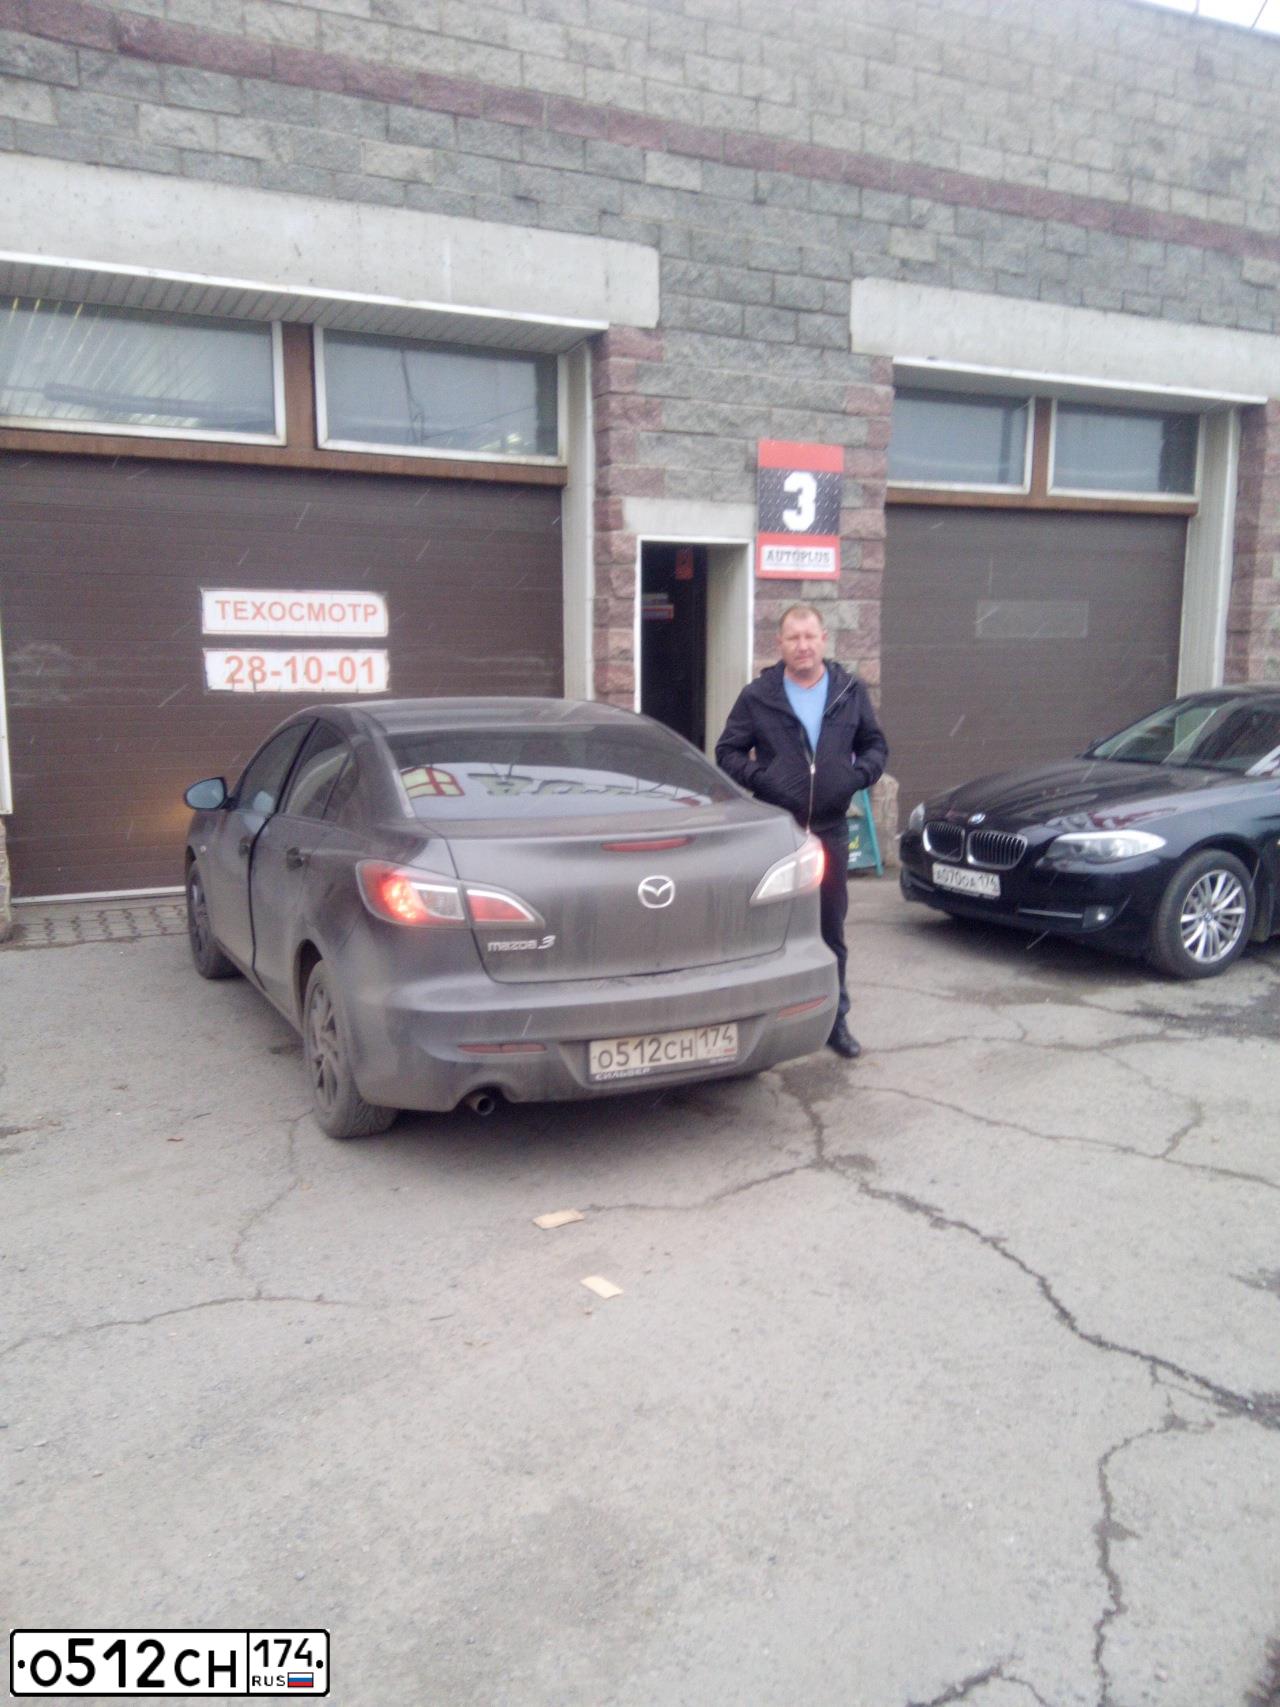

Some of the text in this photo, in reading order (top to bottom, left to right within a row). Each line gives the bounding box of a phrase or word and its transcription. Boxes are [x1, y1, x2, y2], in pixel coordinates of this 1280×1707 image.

[782, 471, 818, 531] 3
[766, 549, 831, 563] AUTOPLUS
[215, 600, 378, 623] ТЕХОСМОТР
[224, 655, 374, 684] 28-10-01
[537, 935, 556, 949] 3
[700, 1026, 733, 1048] 174
